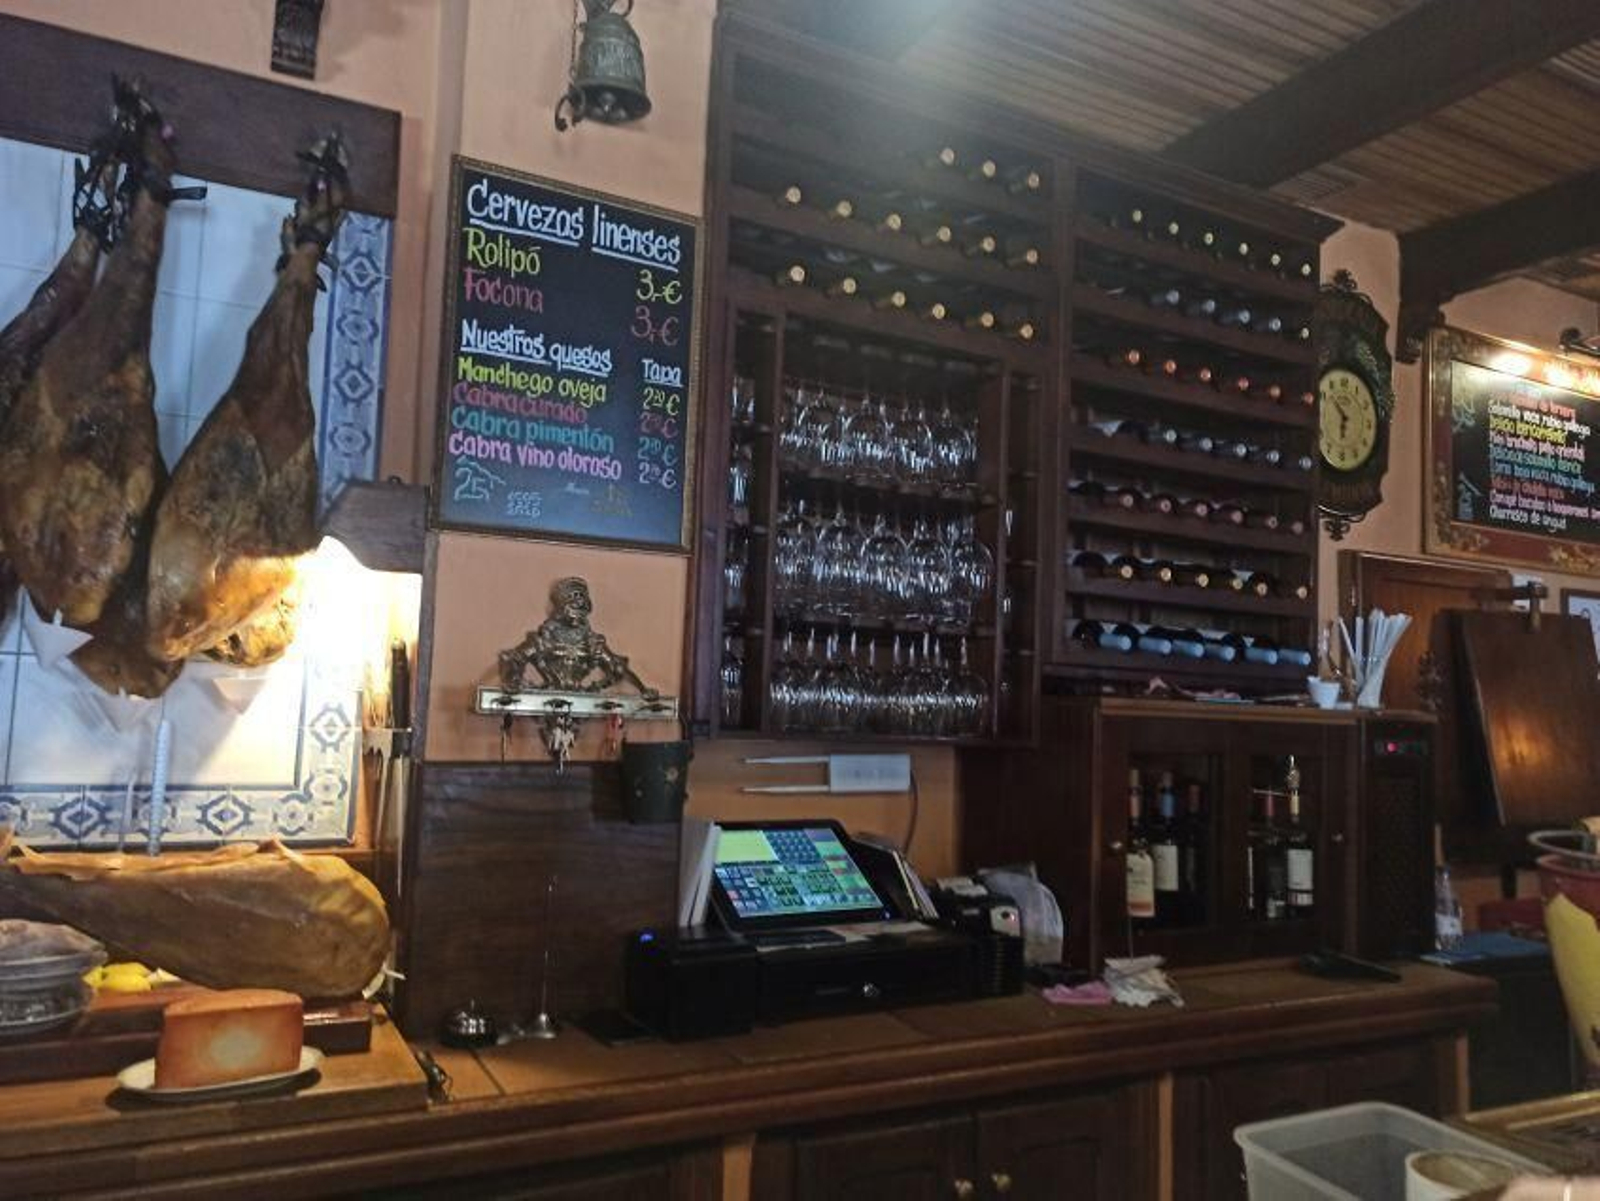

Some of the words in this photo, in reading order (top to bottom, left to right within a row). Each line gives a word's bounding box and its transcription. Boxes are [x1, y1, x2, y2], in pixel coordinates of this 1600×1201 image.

[467, 178, 584, 240] Cervezas
[592, 204, 681, 265] linenses
[463, 227, 541, 278] Rolipó
[461, 318, 546, 359] Nuestros
[550, 343, 613, 373] quesos
[641, 358, 682, 386] Tapa
[458, 356, 553, 398] Manchego
[558, 378, 607, 409] oveja
[449, 431, 512, 464] Cabra
[516, 441, 554, 468] vino
[558, 446, 622, 480] oloroso
[451, 405, 520, 441] Cabra
[526, 420, 615, 454] pimentón
